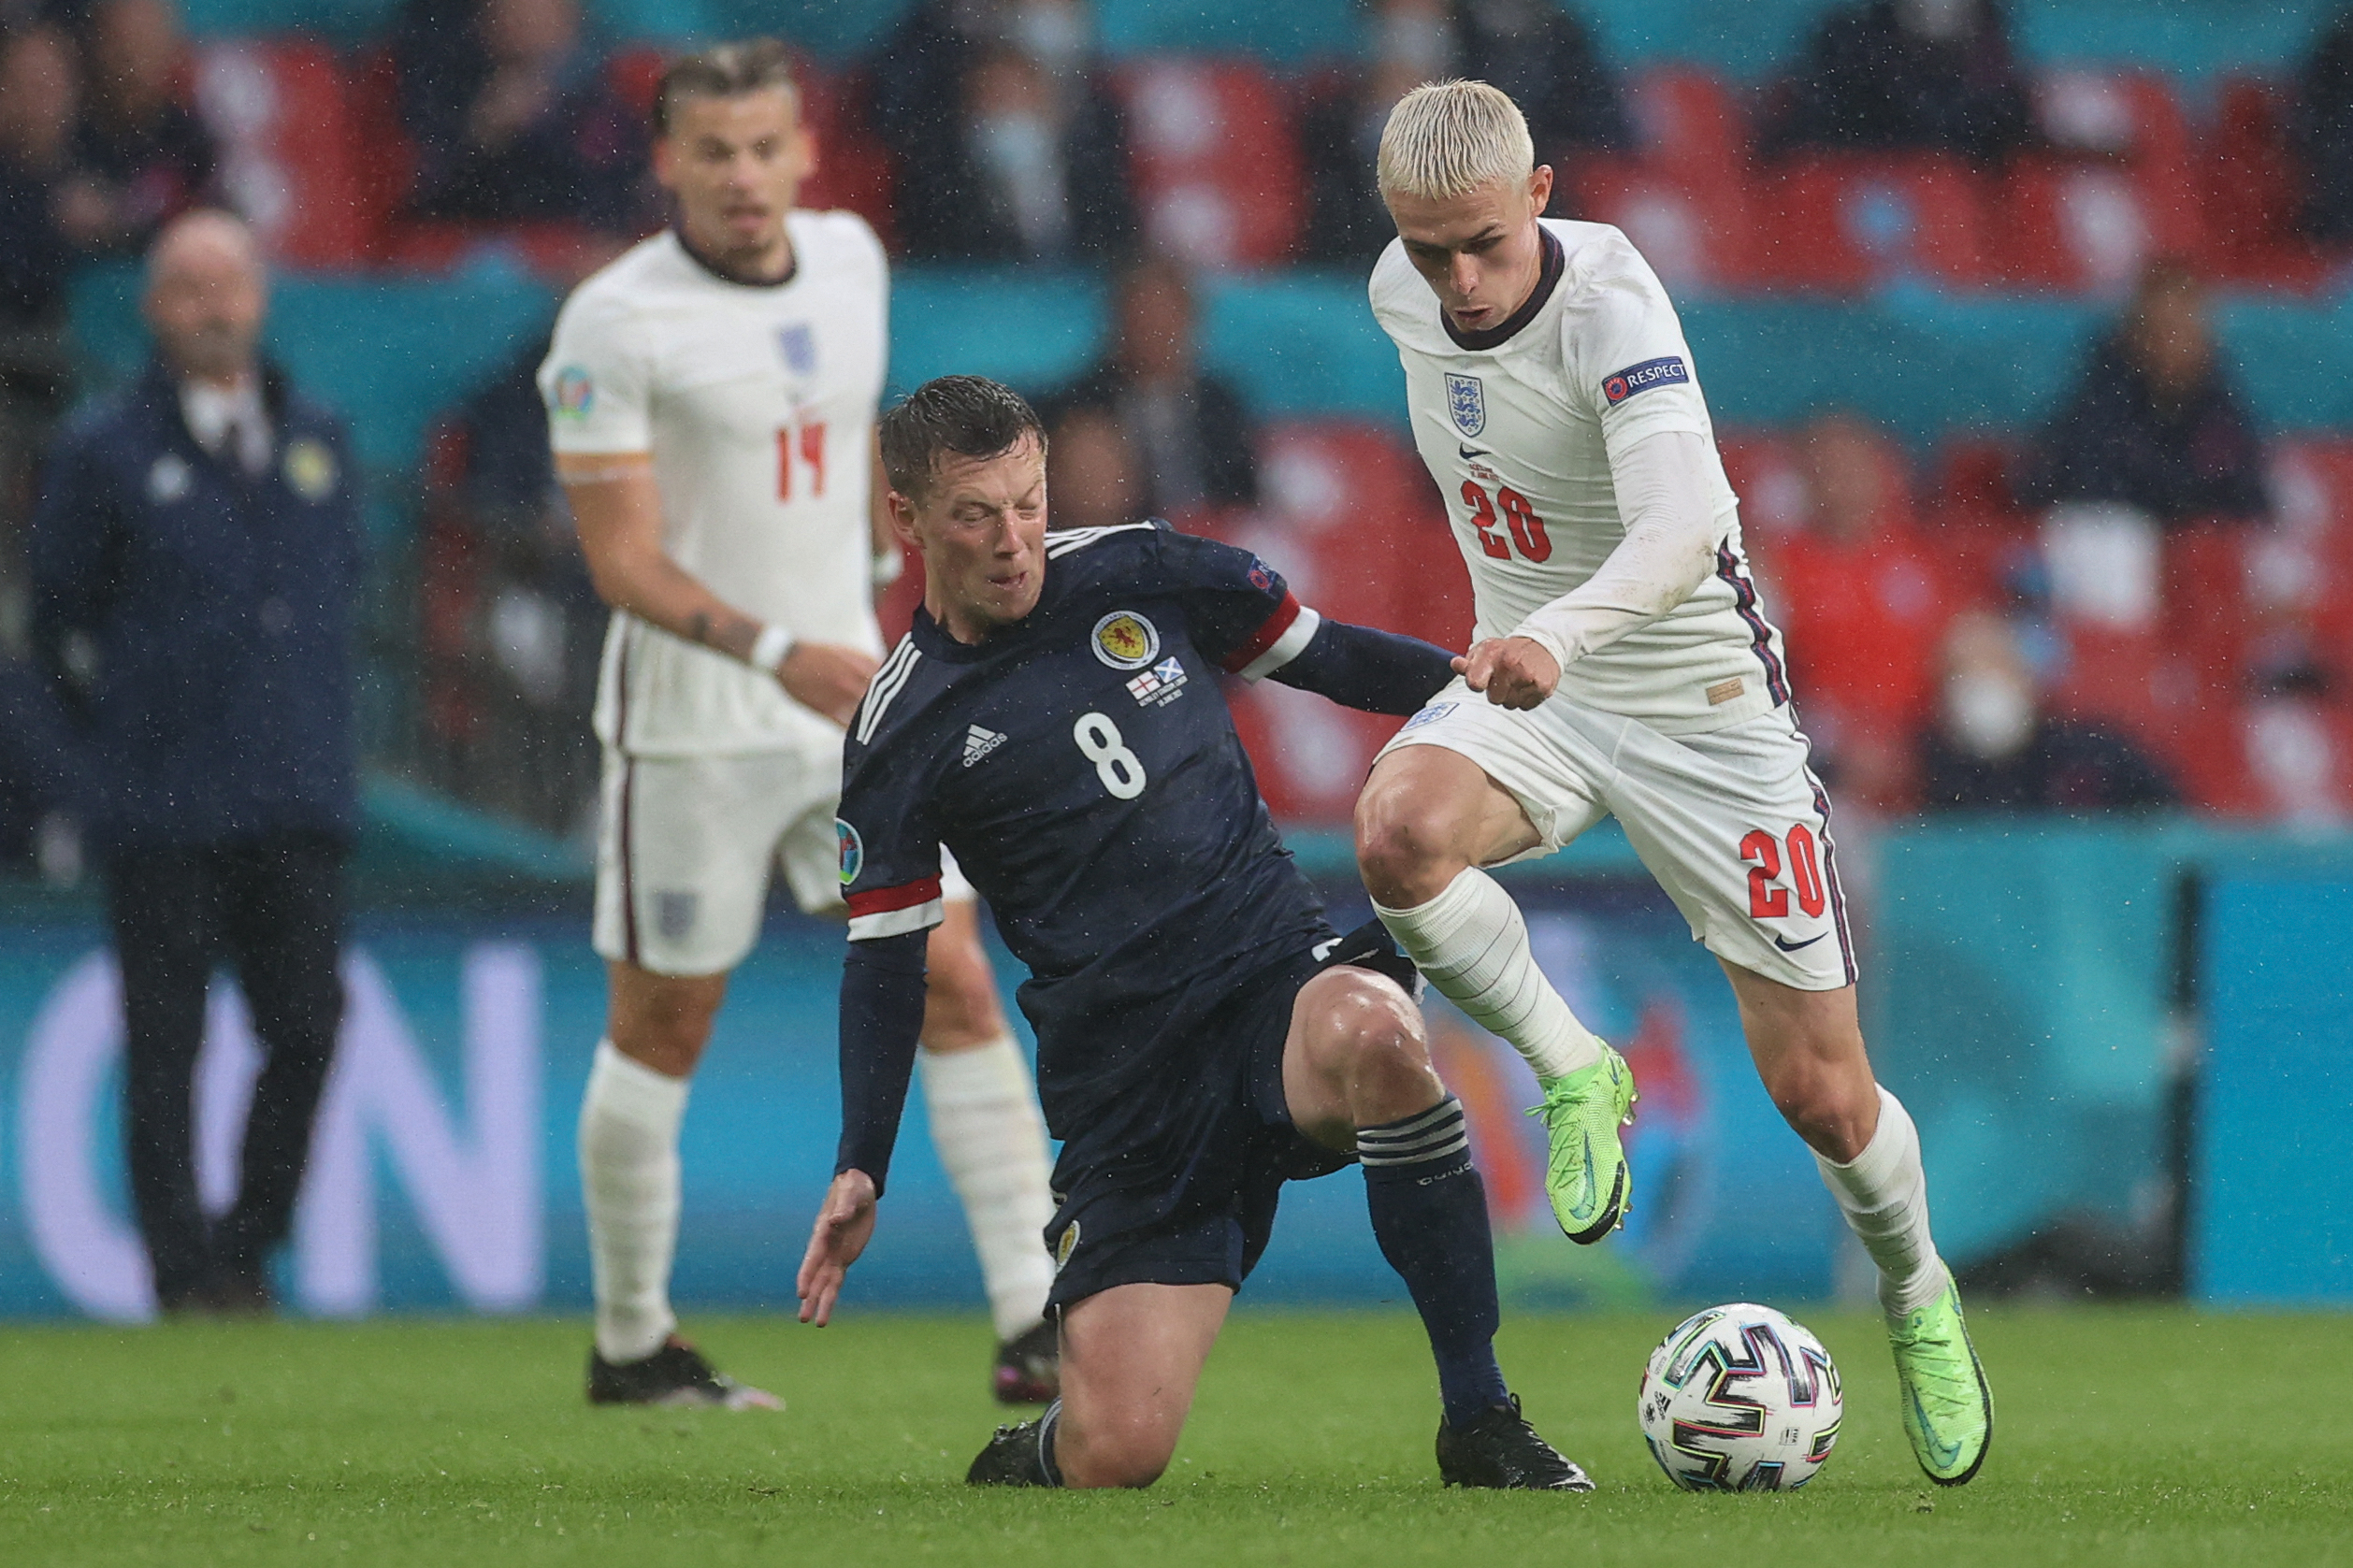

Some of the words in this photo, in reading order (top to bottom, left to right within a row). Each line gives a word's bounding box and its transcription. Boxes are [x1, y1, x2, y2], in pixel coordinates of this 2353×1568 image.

[1627, 364, 1684, 388] RESPECT
[1461, 480, 1552, 563] 20
[962, 732, 1008, 768] adidas
[1074, 712, 1147, 799] 8
[1739, 824, 1825, 918] 20
